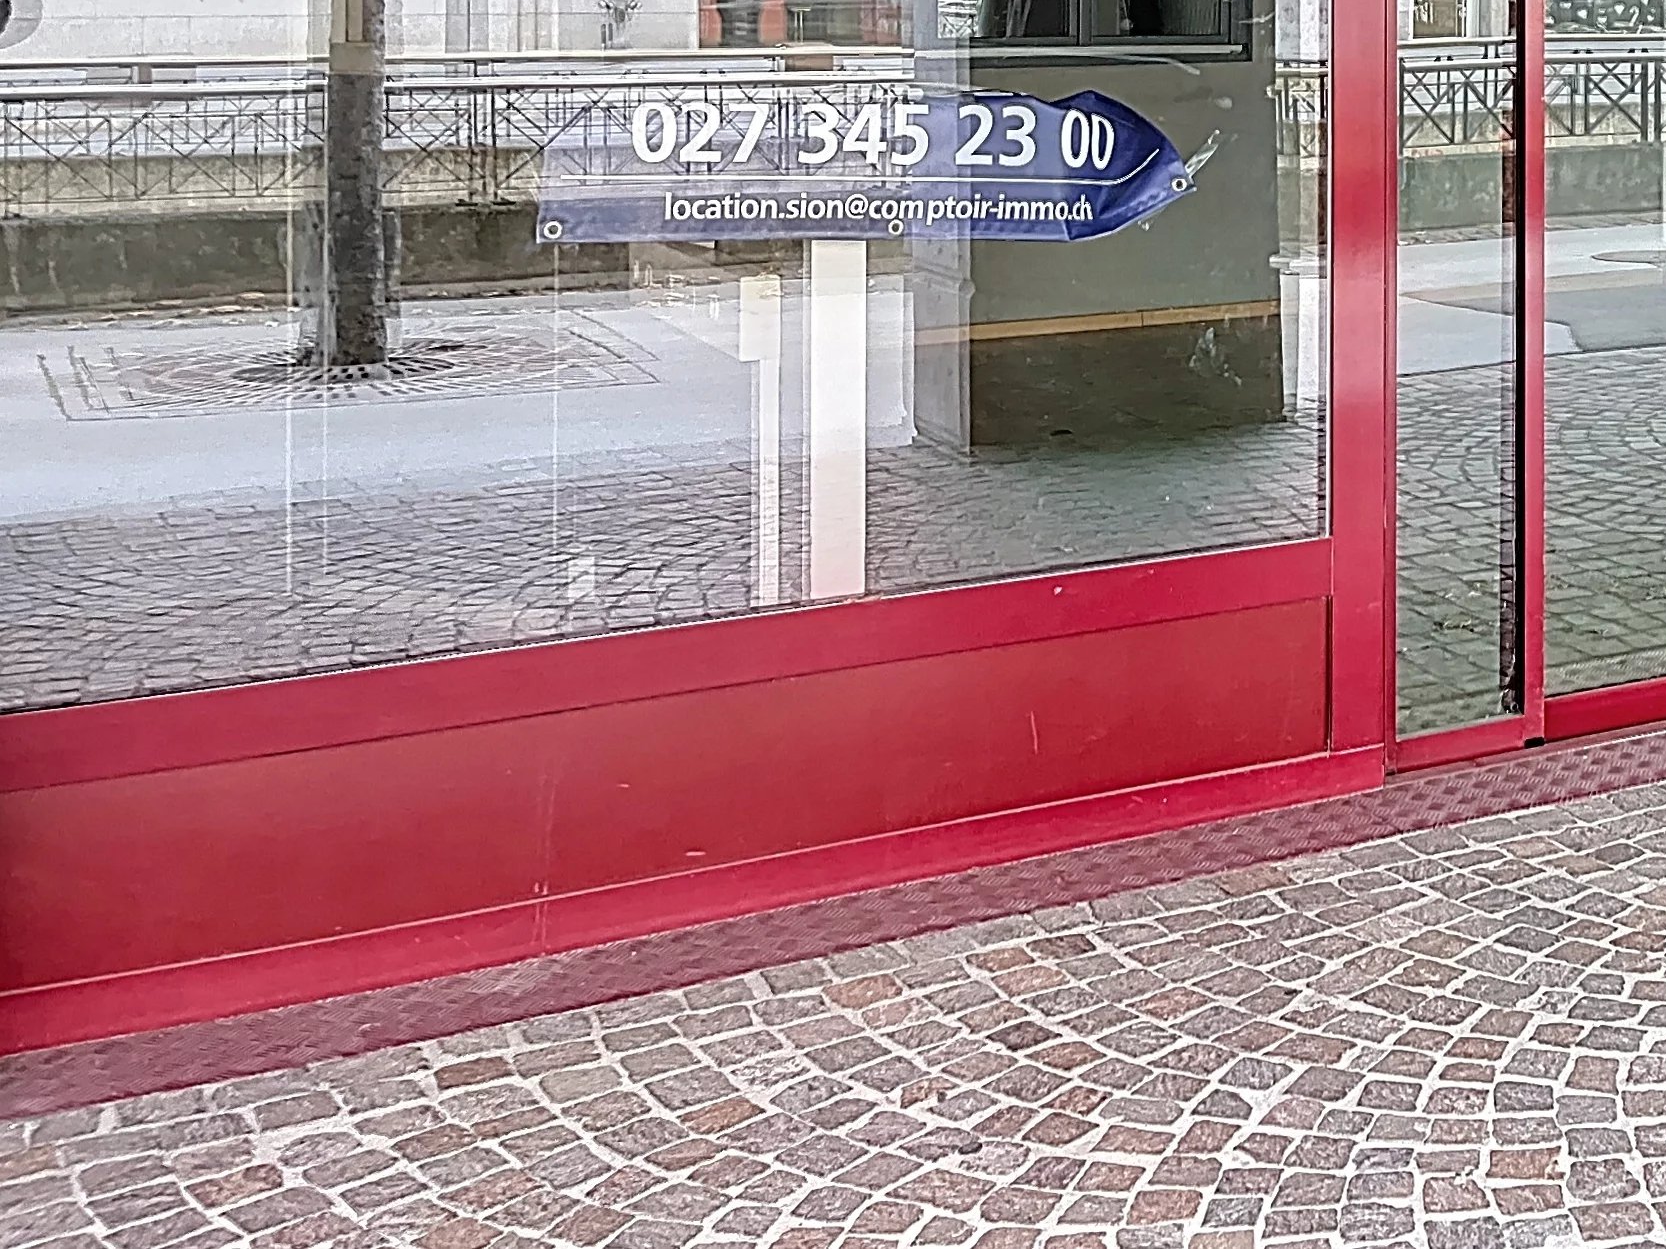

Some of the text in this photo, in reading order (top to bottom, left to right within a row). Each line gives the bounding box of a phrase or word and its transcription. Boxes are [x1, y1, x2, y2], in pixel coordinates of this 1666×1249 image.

[631, 101, 770, 164] 027
[797, 102, 930, 167] 345
[954, 103, 1037, 167] 23
[664, 192, 1094, 226] location.sion@comptoir-immo.ch
